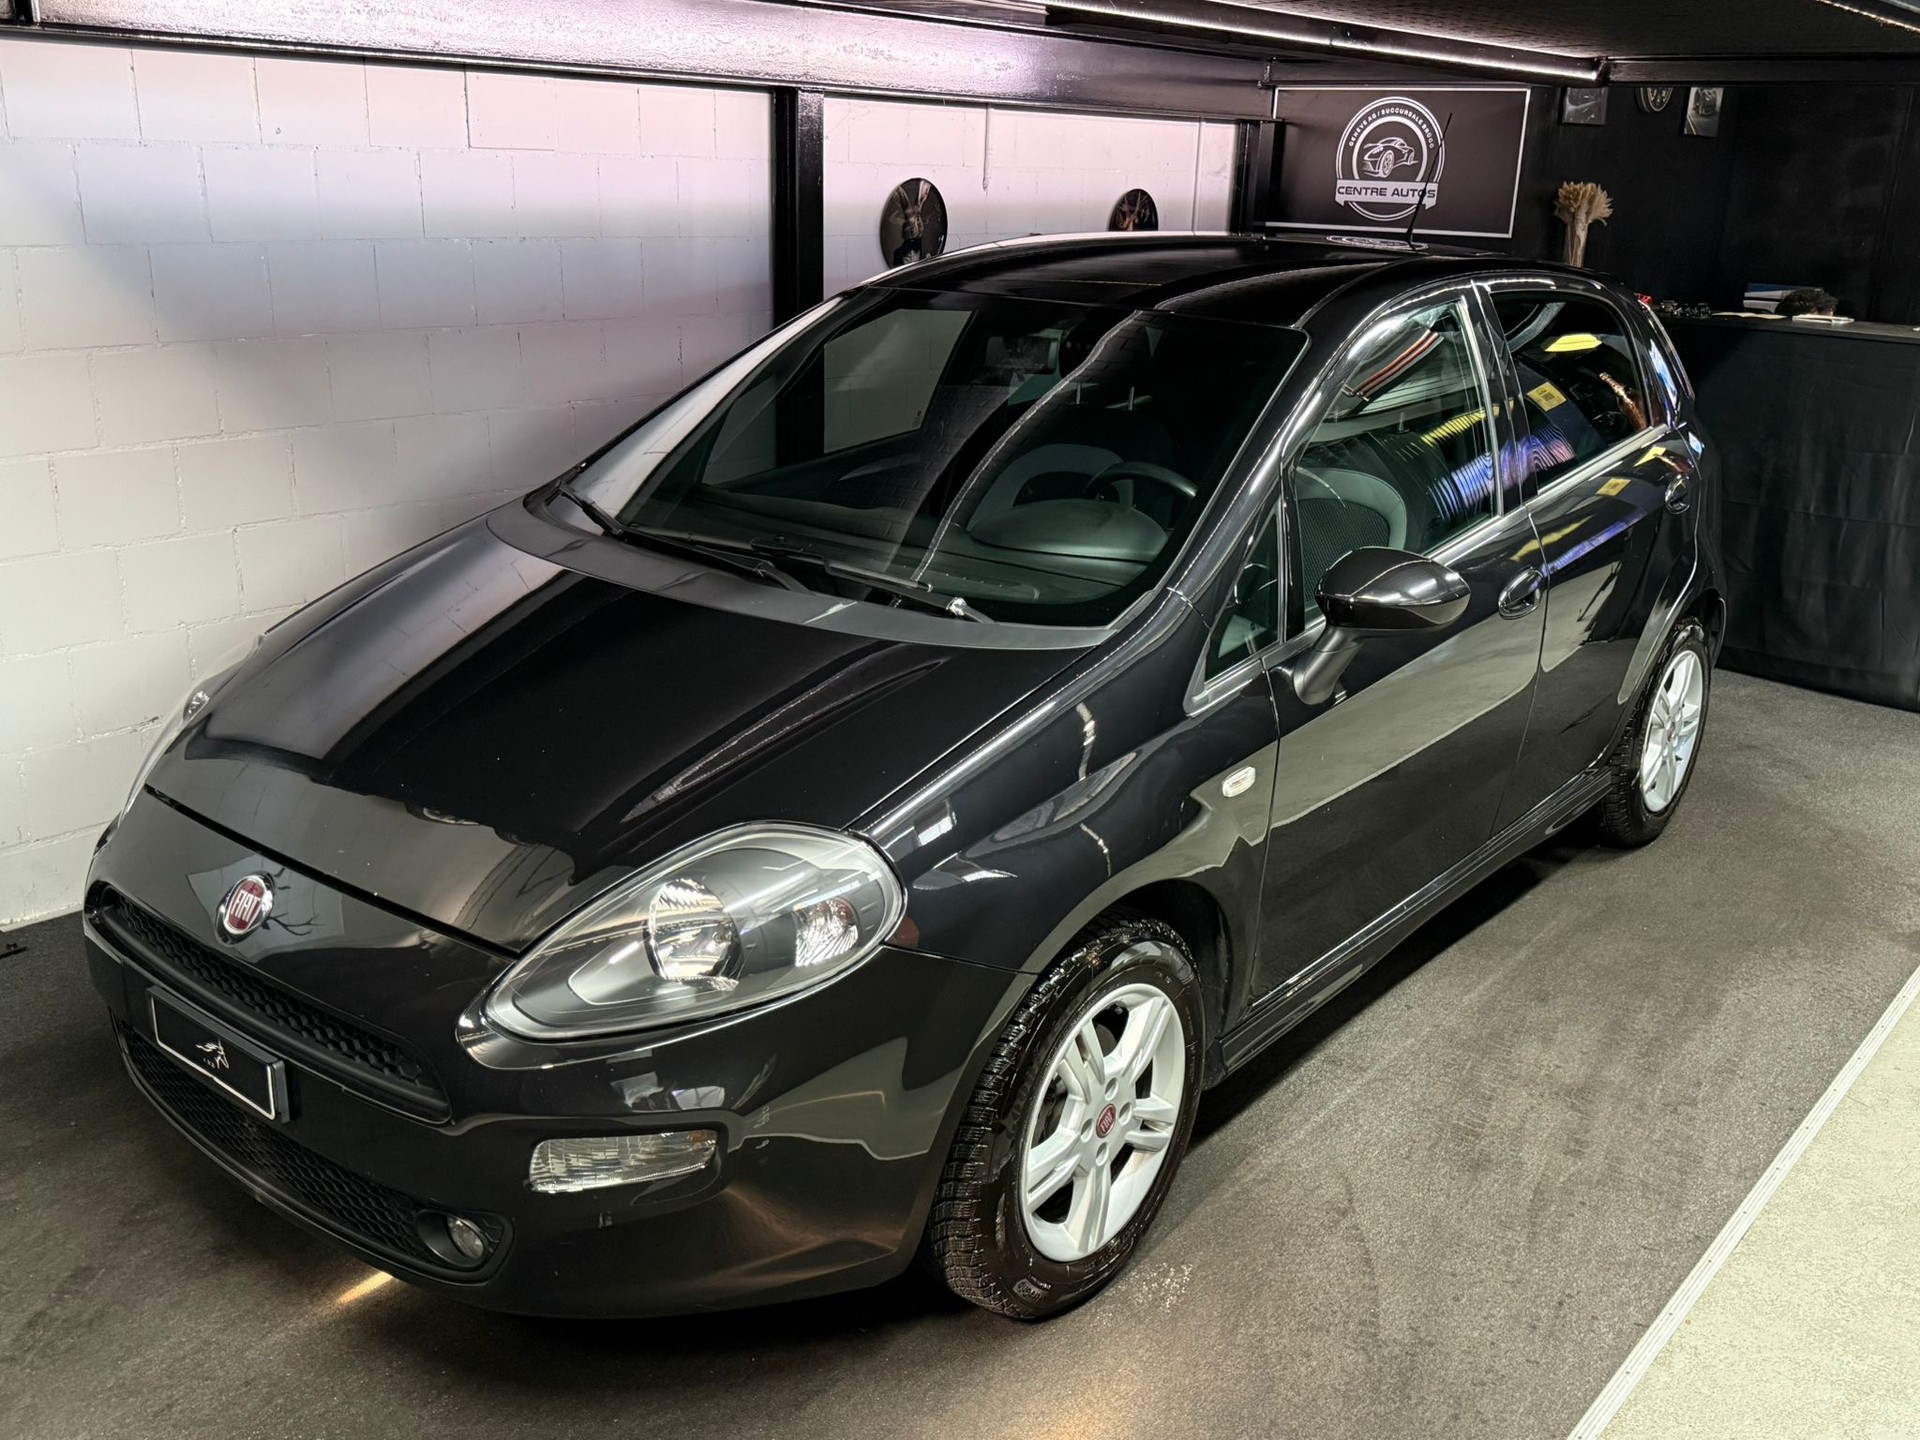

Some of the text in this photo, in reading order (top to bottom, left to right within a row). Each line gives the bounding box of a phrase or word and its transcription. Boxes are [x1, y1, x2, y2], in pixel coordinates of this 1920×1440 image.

[1381, 107, 1423, 125] SUCCURSALE
[1337, 186, 1388, 197] CENTRE
[230, 888, 261, 922] FIAT
[1100, 1110, 1113, 1133] FIAT
